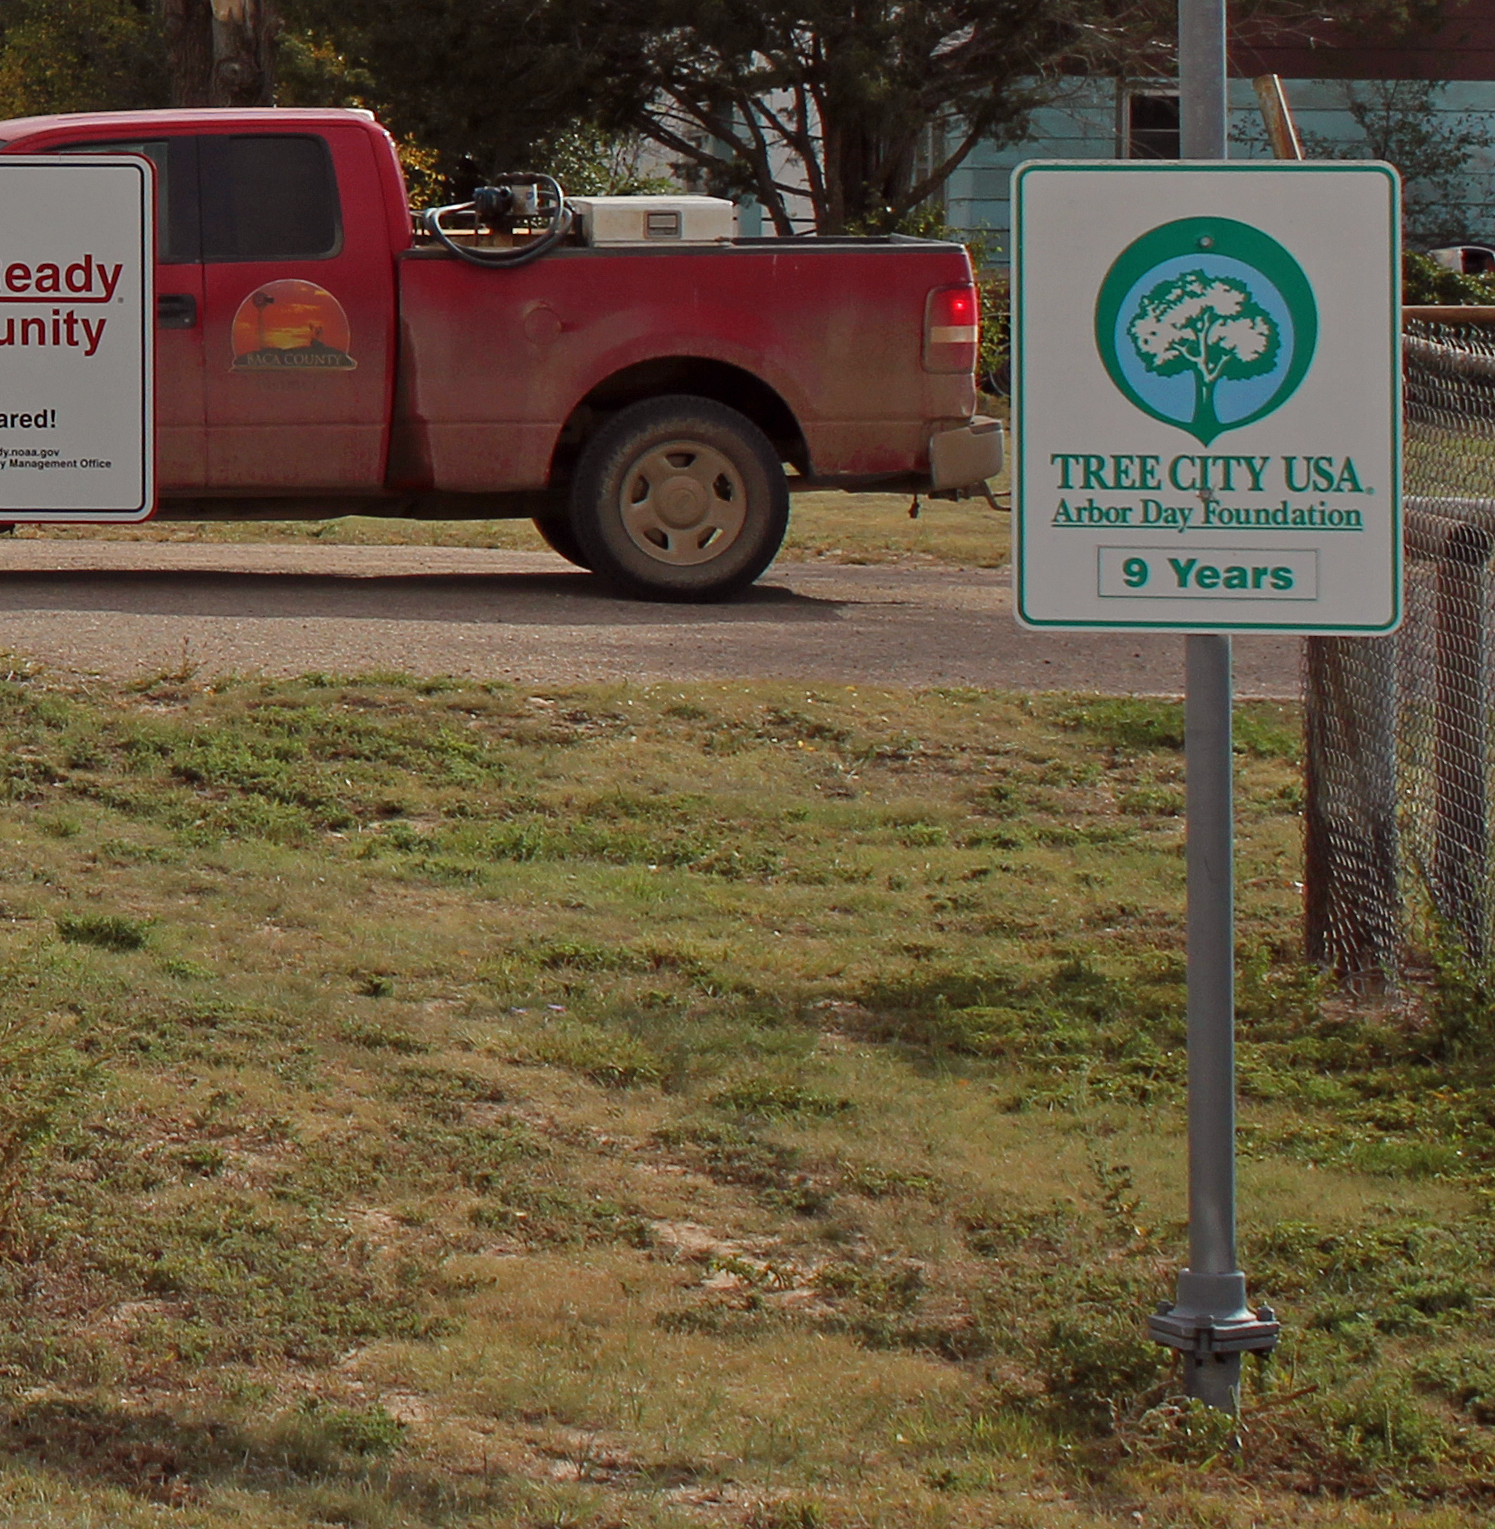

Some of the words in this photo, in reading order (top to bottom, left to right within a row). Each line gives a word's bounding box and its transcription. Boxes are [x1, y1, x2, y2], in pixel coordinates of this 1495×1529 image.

[246, 353, 281, 366] BACA
[283, 353, 343, 366] COUNTY
[9, 458, 77, 470] Management
[79, 458, 112, 469] Office
[1050, 453, 1162, 491] TREE
[1168, 454, 1271, 492] CITY
[1281, 455, 1365, 494] USA
[1052, 497, 1133, 524] Arbor
[1138, 498, 1194, 534] Day
[1201, 499, 1364, 527] Foundation
[1121, 556, 1150, 589] 9
[1167, 557, 1295, 591] Years
